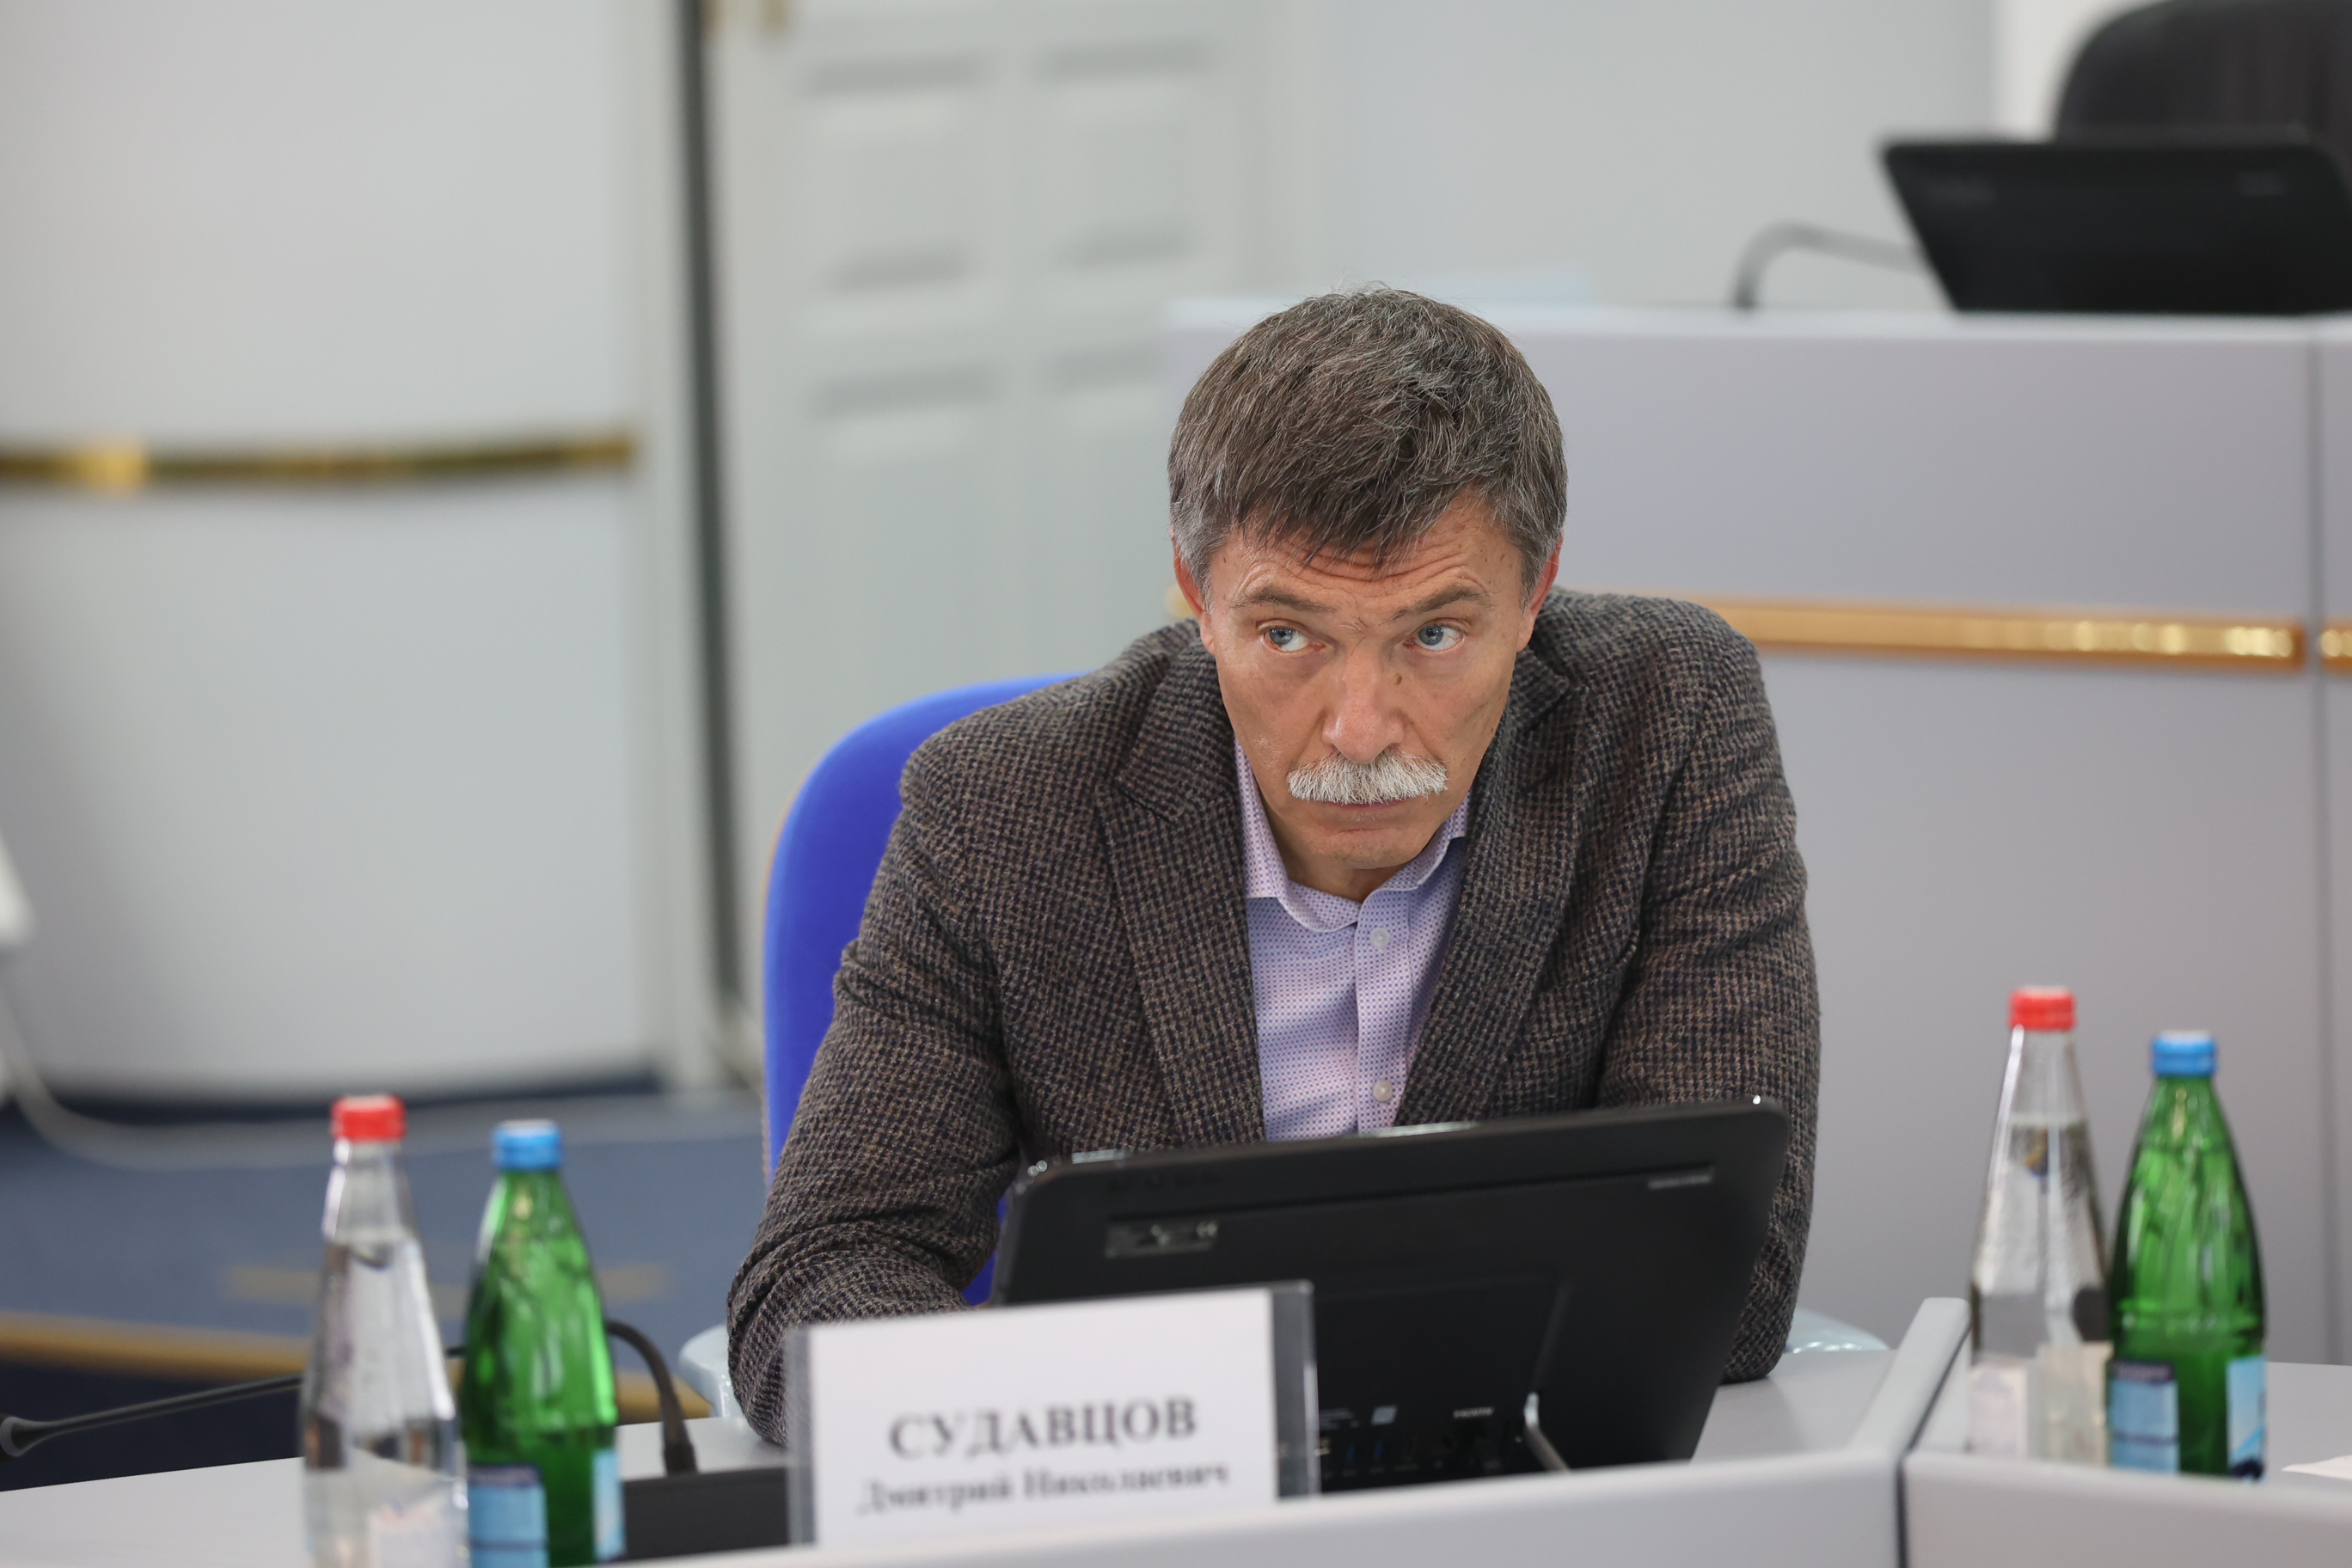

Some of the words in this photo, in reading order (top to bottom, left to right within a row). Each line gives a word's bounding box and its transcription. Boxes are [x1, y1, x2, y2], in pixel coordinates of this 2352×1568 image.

[888, 1397, 1196, 1460] СУДАВЦОВ
[858, 1476, 1013, 1515] Дмитрий
[1023, 1463, 1229, 1498] Николаевич
